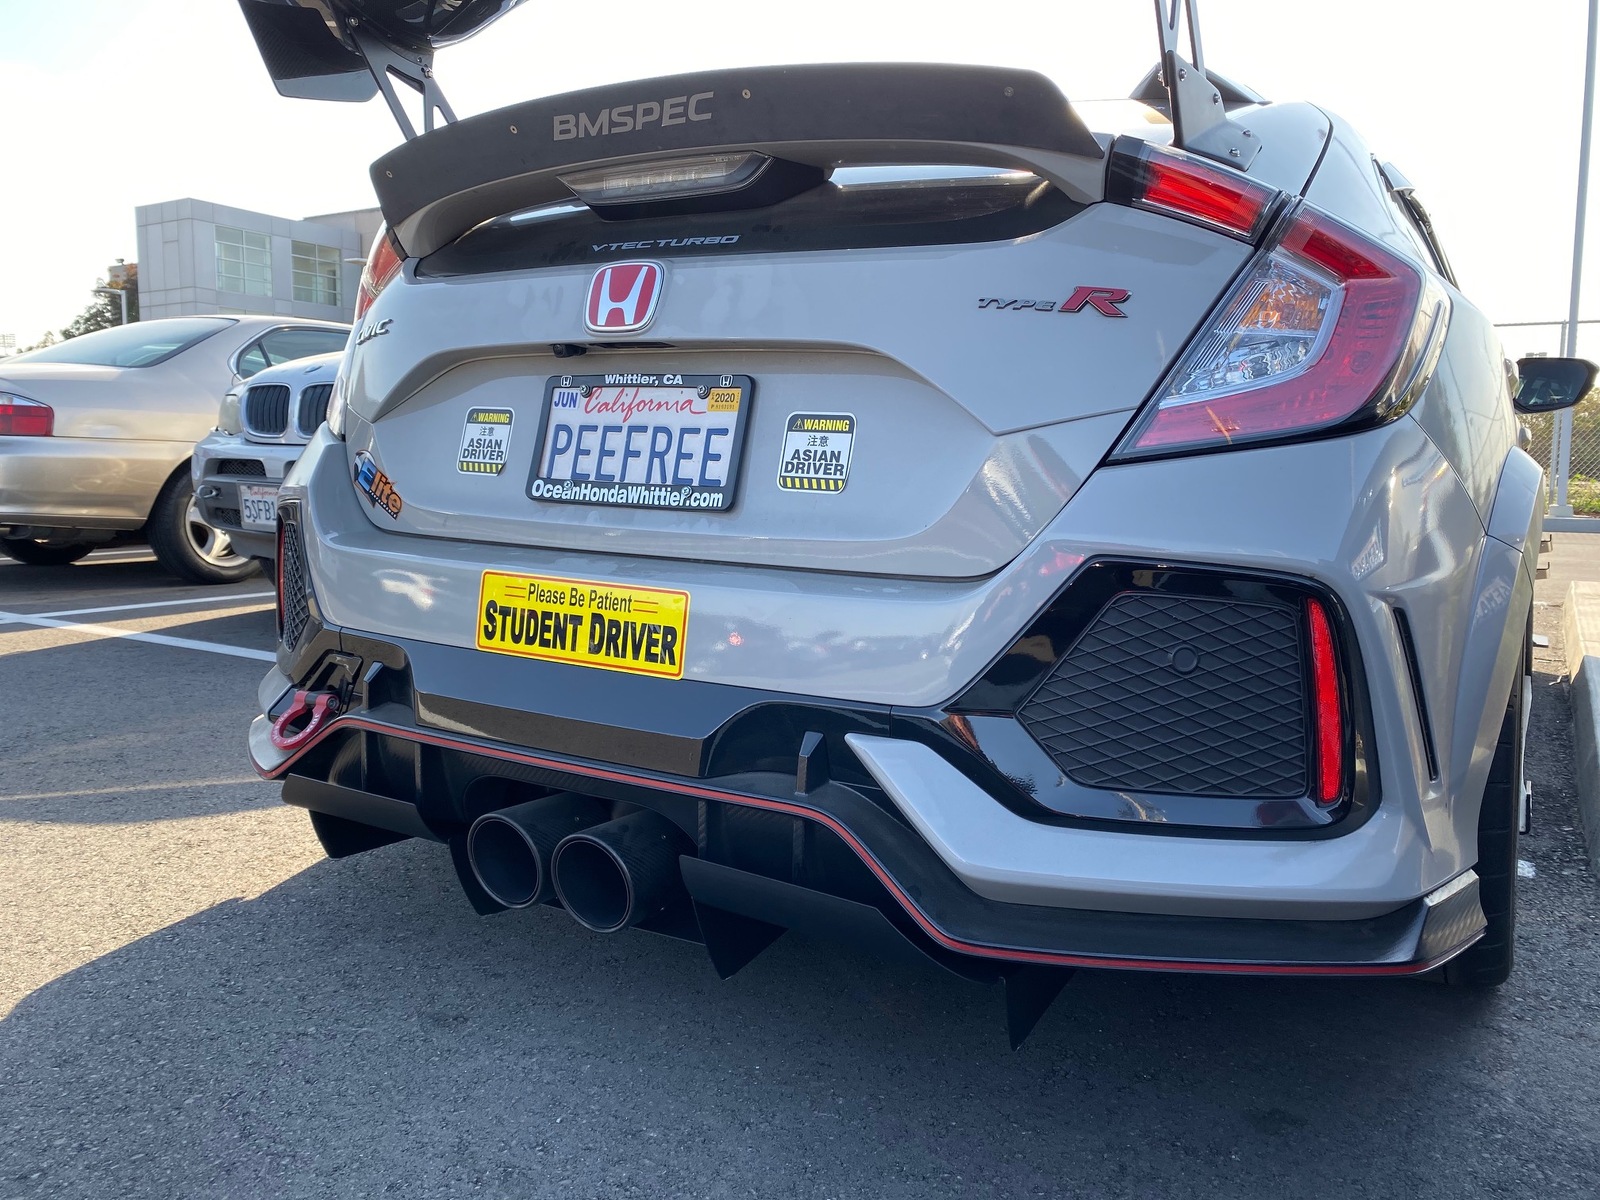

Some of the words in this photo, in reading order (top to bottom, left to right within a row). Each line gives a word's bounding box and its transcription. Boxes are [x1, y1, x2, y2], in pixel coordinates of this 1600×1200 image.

[553, 91, 714, 141] BMSPEC
[592, 240, 655, 252] VTEC
[656, 234, 742, 248] TURBO
[978, 297, 1057, 313] TYPE
[1058, 285, 1133, 318] R
[604, 374, 659, 386] Whittier,
[663, 374, 683, 385] CA
[553, 391, 579, 408] JUN
[584, 387, 707, 423] California
[715, 393, 736, 403] 2020
[478, 412, 510, 423] WARNING
[804, 419, 850, 431] WARNING
[467, 438, 502, 449] ASIAN
[807, 435, 829, 447] 注意
[462, 448, 504, 461] DRIVER
[547, 423, 729, 487] PEEFREE
[790, 449, 842, 463] ASIAN
[784, 461, 845, 476] DRIVER
[357, 457, 402, 514] Elite
[531, 479, 723, 508] OceanHondaWhittier.com
[528, 583, 566, 605] Please
[569, 587, 585, 608] Be
[588, 589, 633, 614] Patient
[483, 599, 584, 652] STUDENT
[588, 612, 678, 666] DRIVER
